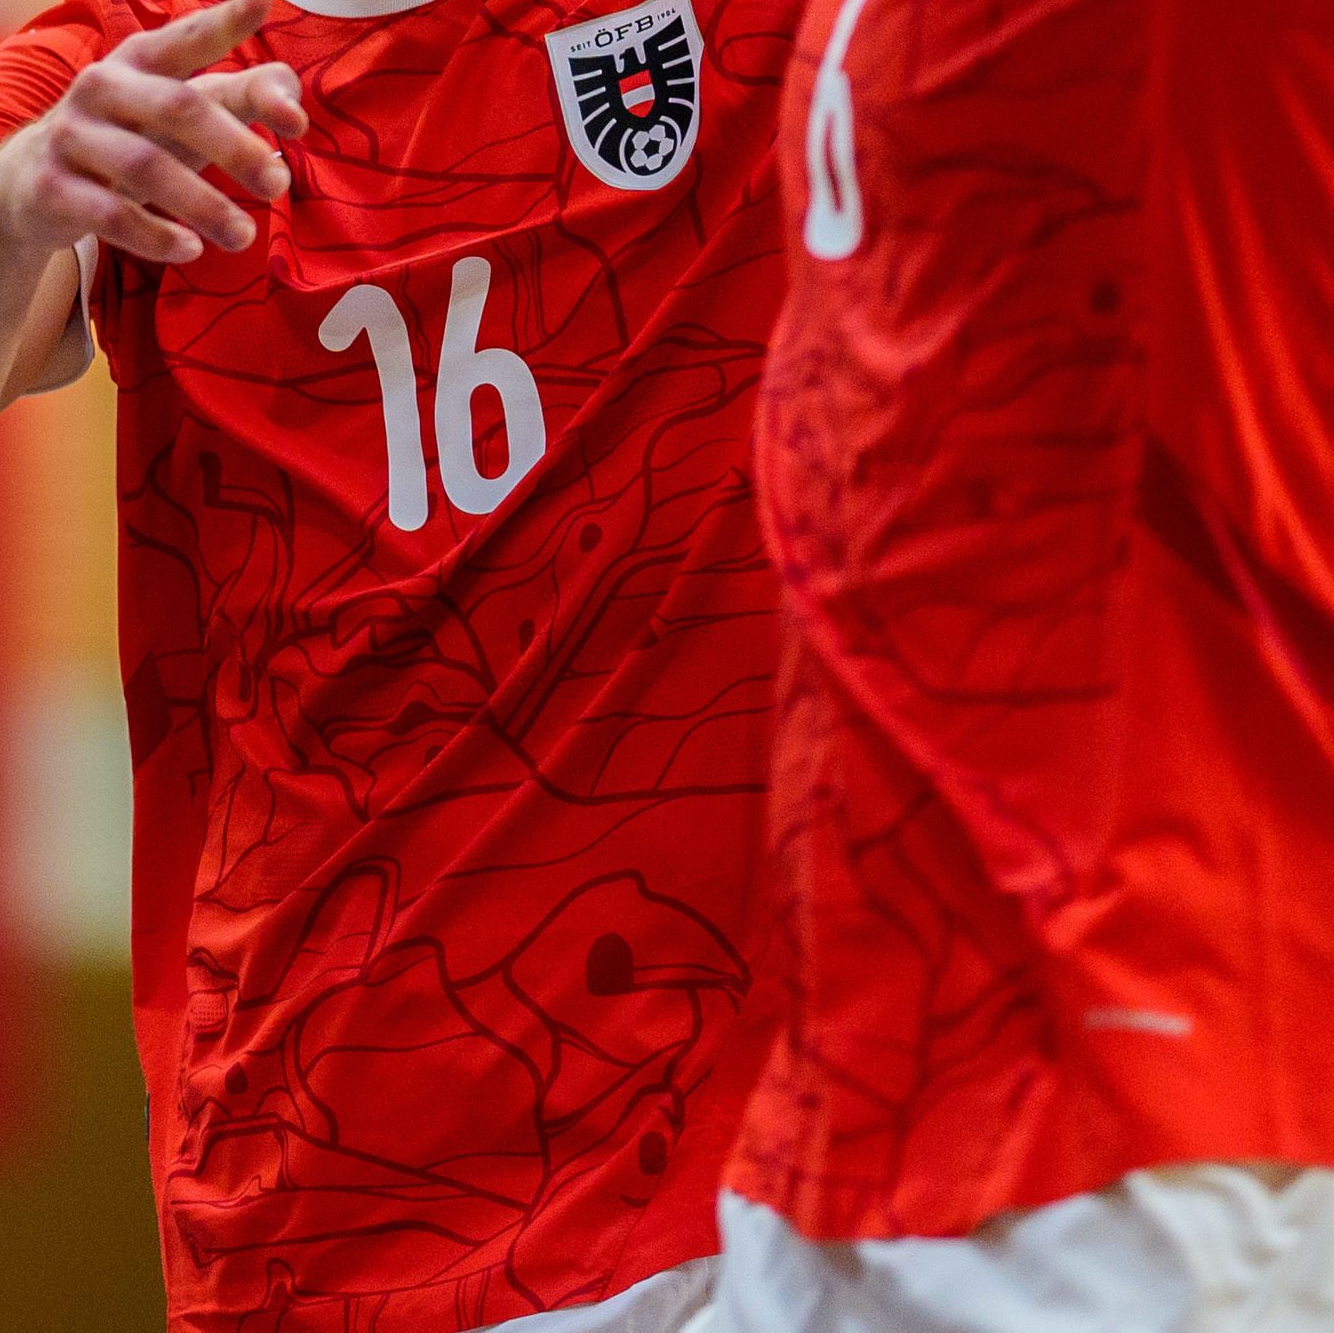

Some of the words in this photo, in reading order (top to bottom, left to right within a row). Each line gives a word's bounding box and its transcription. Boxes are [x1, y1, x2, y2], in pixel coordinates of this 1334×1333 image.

[570, 40, 591, 53] SEIT
[594, 14, 654, 48] ÖFB
[656, 7, 676, 21] 1904
[318, 256, 546, 532] 16
